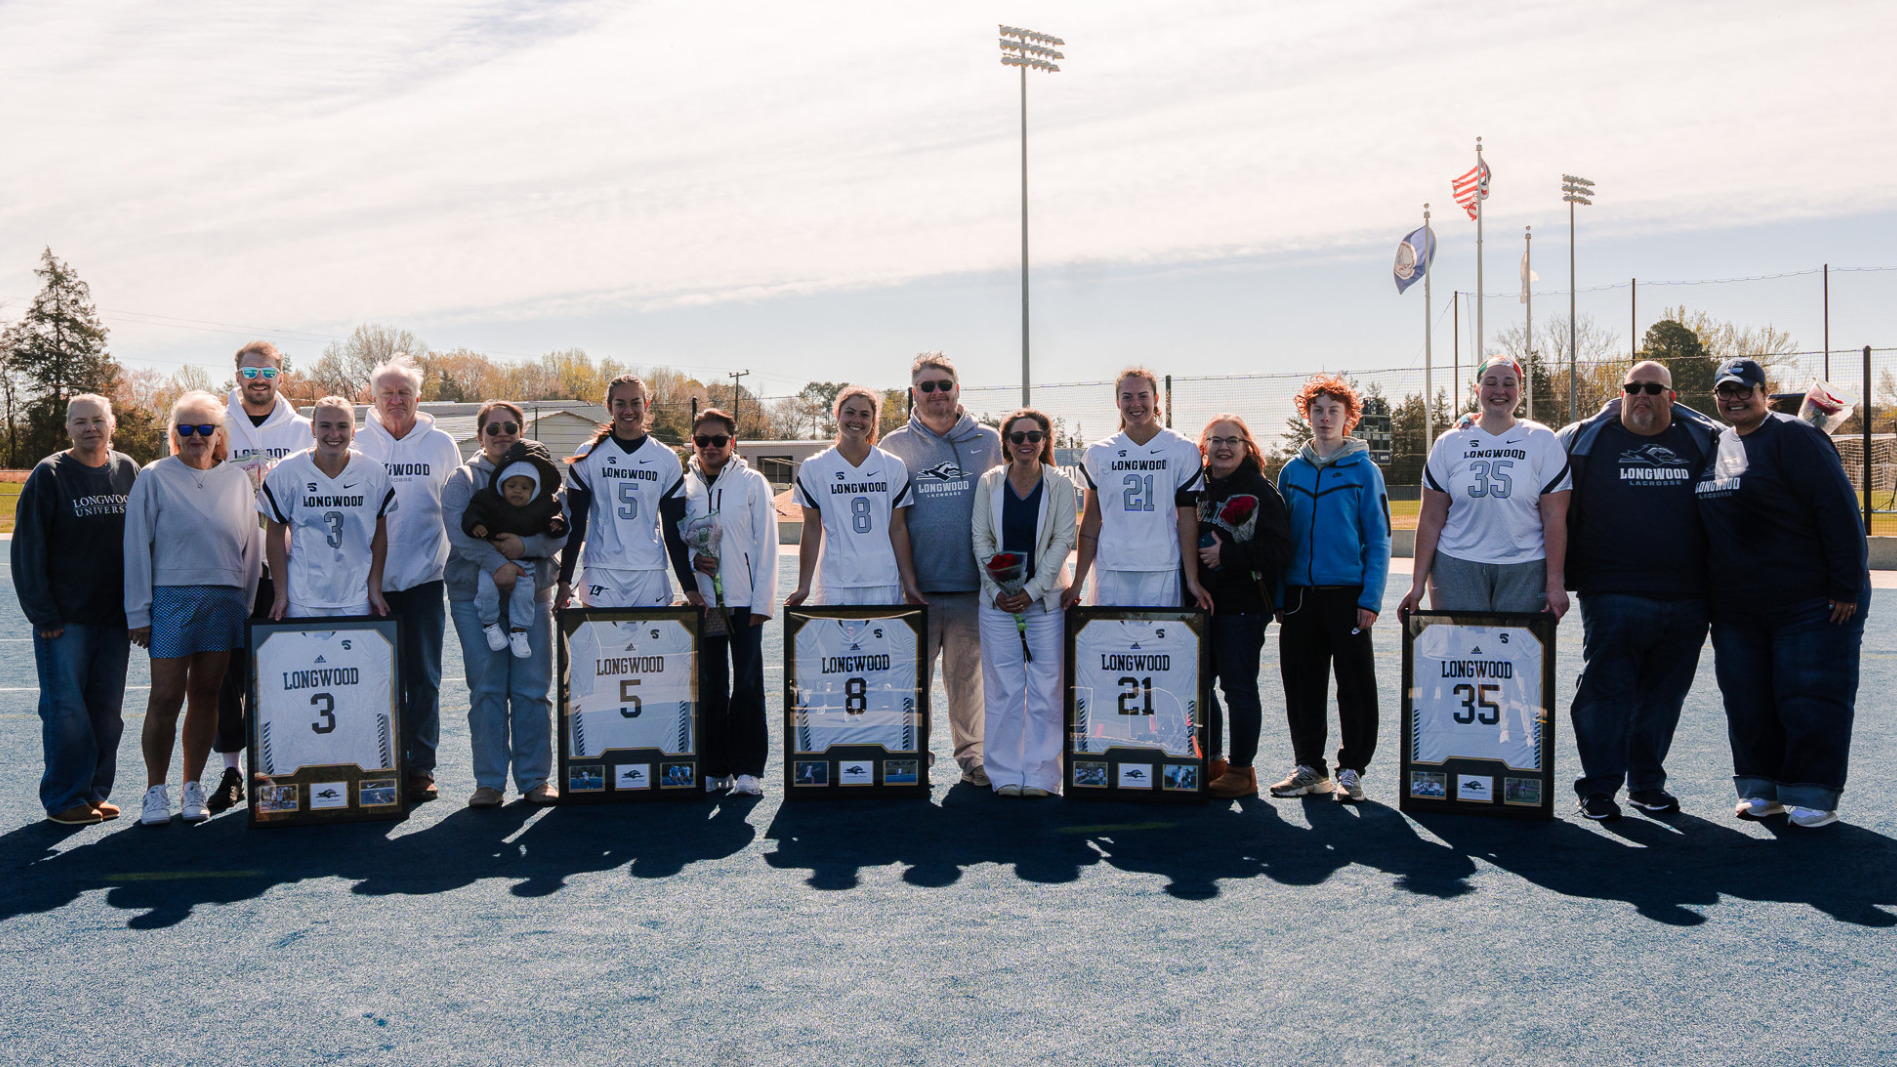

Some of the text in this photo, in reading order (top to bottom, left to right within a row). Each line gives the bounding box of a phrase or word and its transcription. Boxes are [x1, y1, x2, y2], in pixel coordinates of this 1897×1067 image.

[1111, 459, 1167, 471] LONGWOOD
[1464, 449, 1526, 460] LONGWOOD
[602, 467, 658, 482] LONGWOOD
[1467, 460, 1514, 499] 35
[1620, 468, 1690, 480] LONGWOOD
[830, 482, 887, 495] LONGWOOD
[918, 481, 969, 493] LONGWOOD
[1123, 473, 1155, 512] 21
[75, 505, 126, 517] UNIVERS
[303, 495, 364, 507] LONGWOOD
[618, 482, 639, 520] 5
[851, 496, 872, 534] 8
[323, 511, 344, 549] 3
[596, 656, 664, 676] LONGWOOD
[821, 653, 890, 674] LONGWOOD
[1101, 653, 1170, 671] LONGWOOD
[1441, 660, 1512, 679] LONGWOOD
[283, 667, 359, 690] LONGWOOD
[619, 679, 642, 718] 5
[845, 677, 867, 715] 8
[1117, 676, 1154, 716] 21
[1453, 683, 1501, 725] 35
[310, 692, 336, 734] 3
